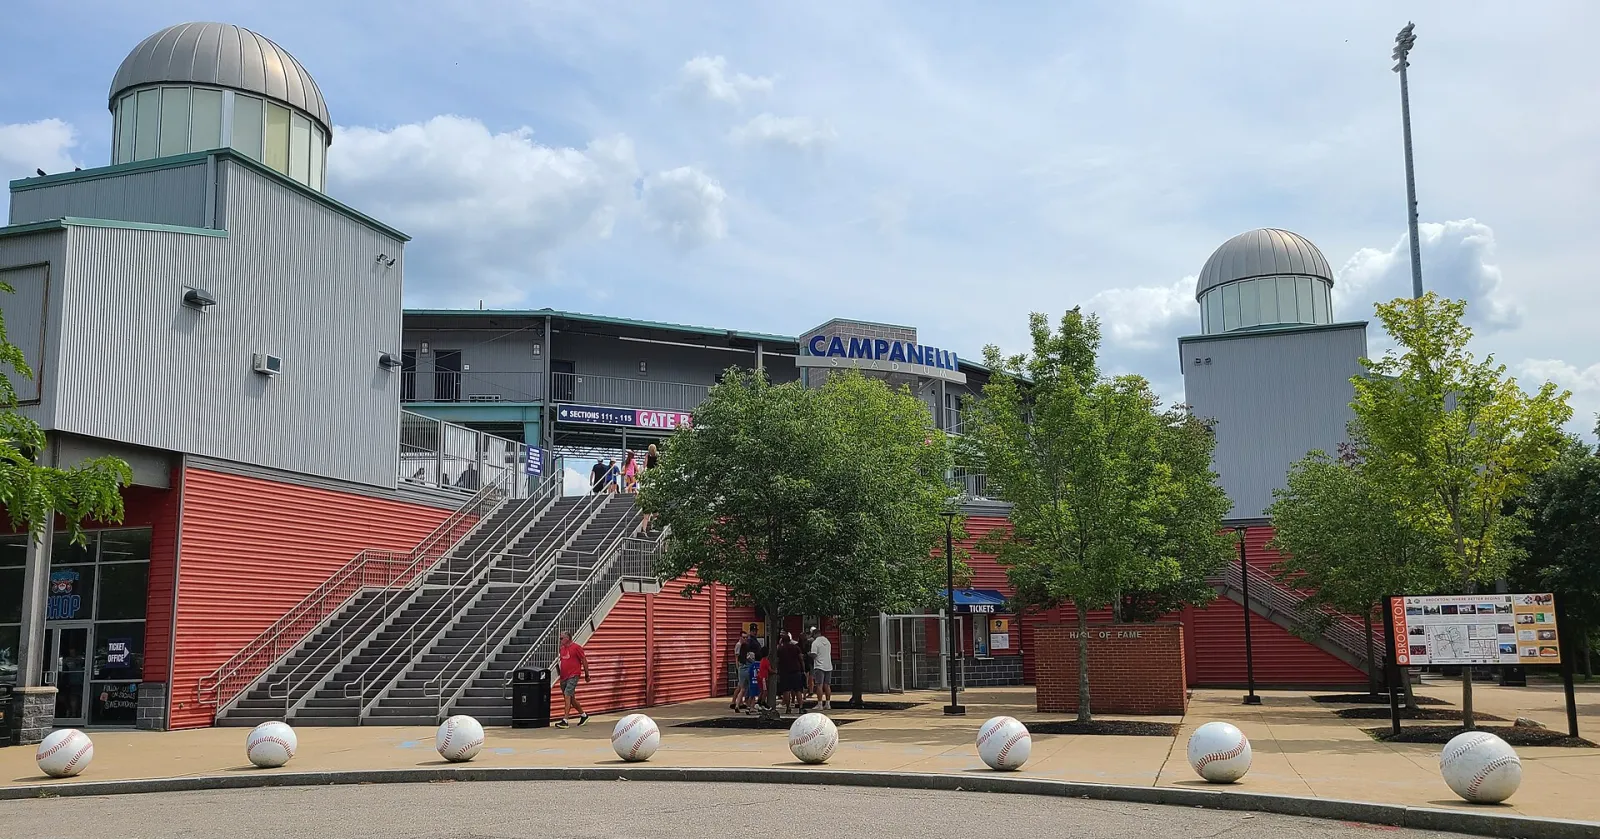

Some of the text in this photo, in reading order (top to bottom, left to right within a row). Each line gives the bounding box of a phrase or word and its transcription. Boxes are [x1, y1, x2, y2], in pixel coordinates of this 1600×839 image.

[809, 335, 959, 372] CAMPANELLI
[831, 357, 948, 378] STADIUM
[569, 410, 599, 420] SECTIONS
[601, 413, 613, 421] 111
[620, 414, 632, 422] 115
[639, 411, 676, 428] GATE
[969, 604, 995, 613] TICKETS
[1393, 598, 1407, 654] BROCKTON
[1098, 631, 1112, 639] OF
[1117, 631, 1142, 639] FAME
[108, 642, 125, 651] TICKET
[107, 654, 124, 663] OFFICE
